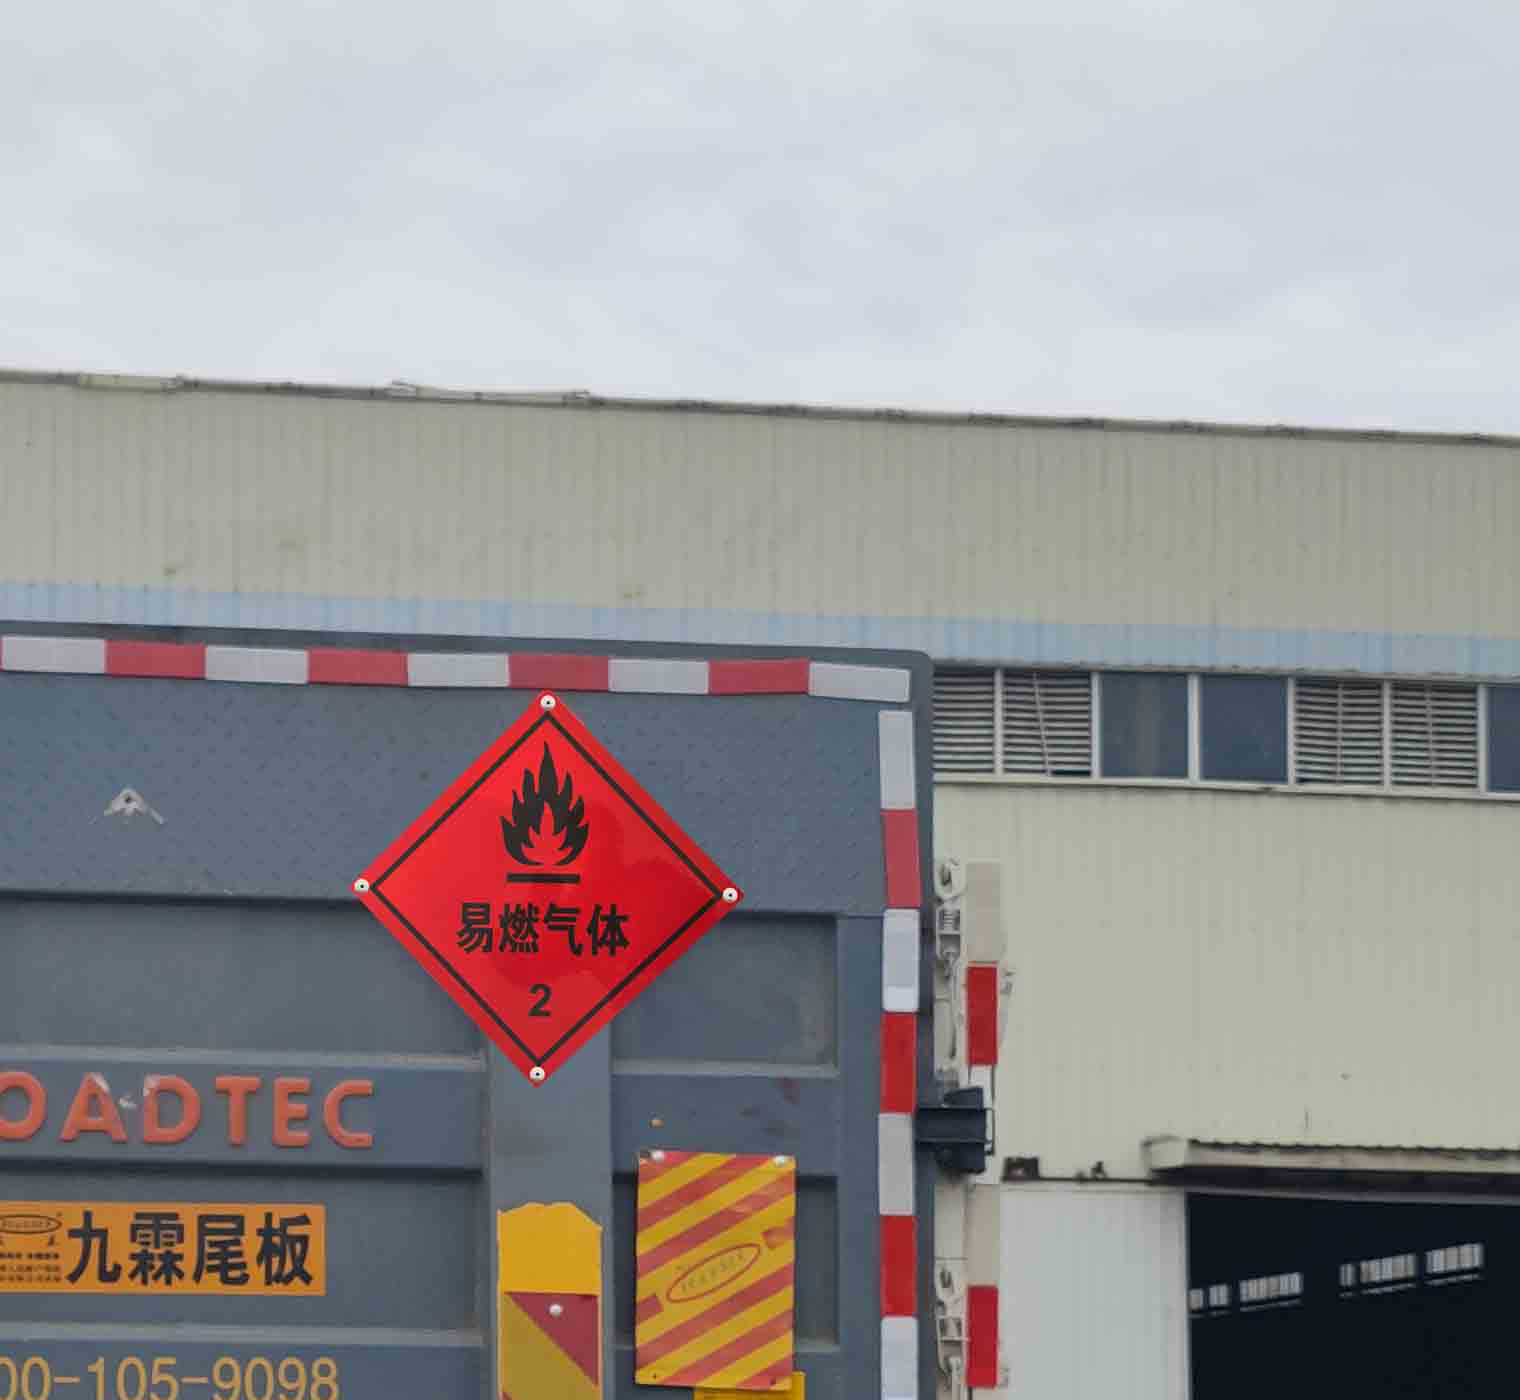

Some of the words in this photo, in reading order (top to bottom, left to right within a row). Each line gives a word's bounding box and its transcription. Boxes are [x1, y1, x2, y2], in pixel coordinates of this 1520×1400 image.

[456, 902, 630, 957] 易燃气体
[528, 983, 552, 1017] 2
[67, 1210, 314, 1287] 九霖尾板
